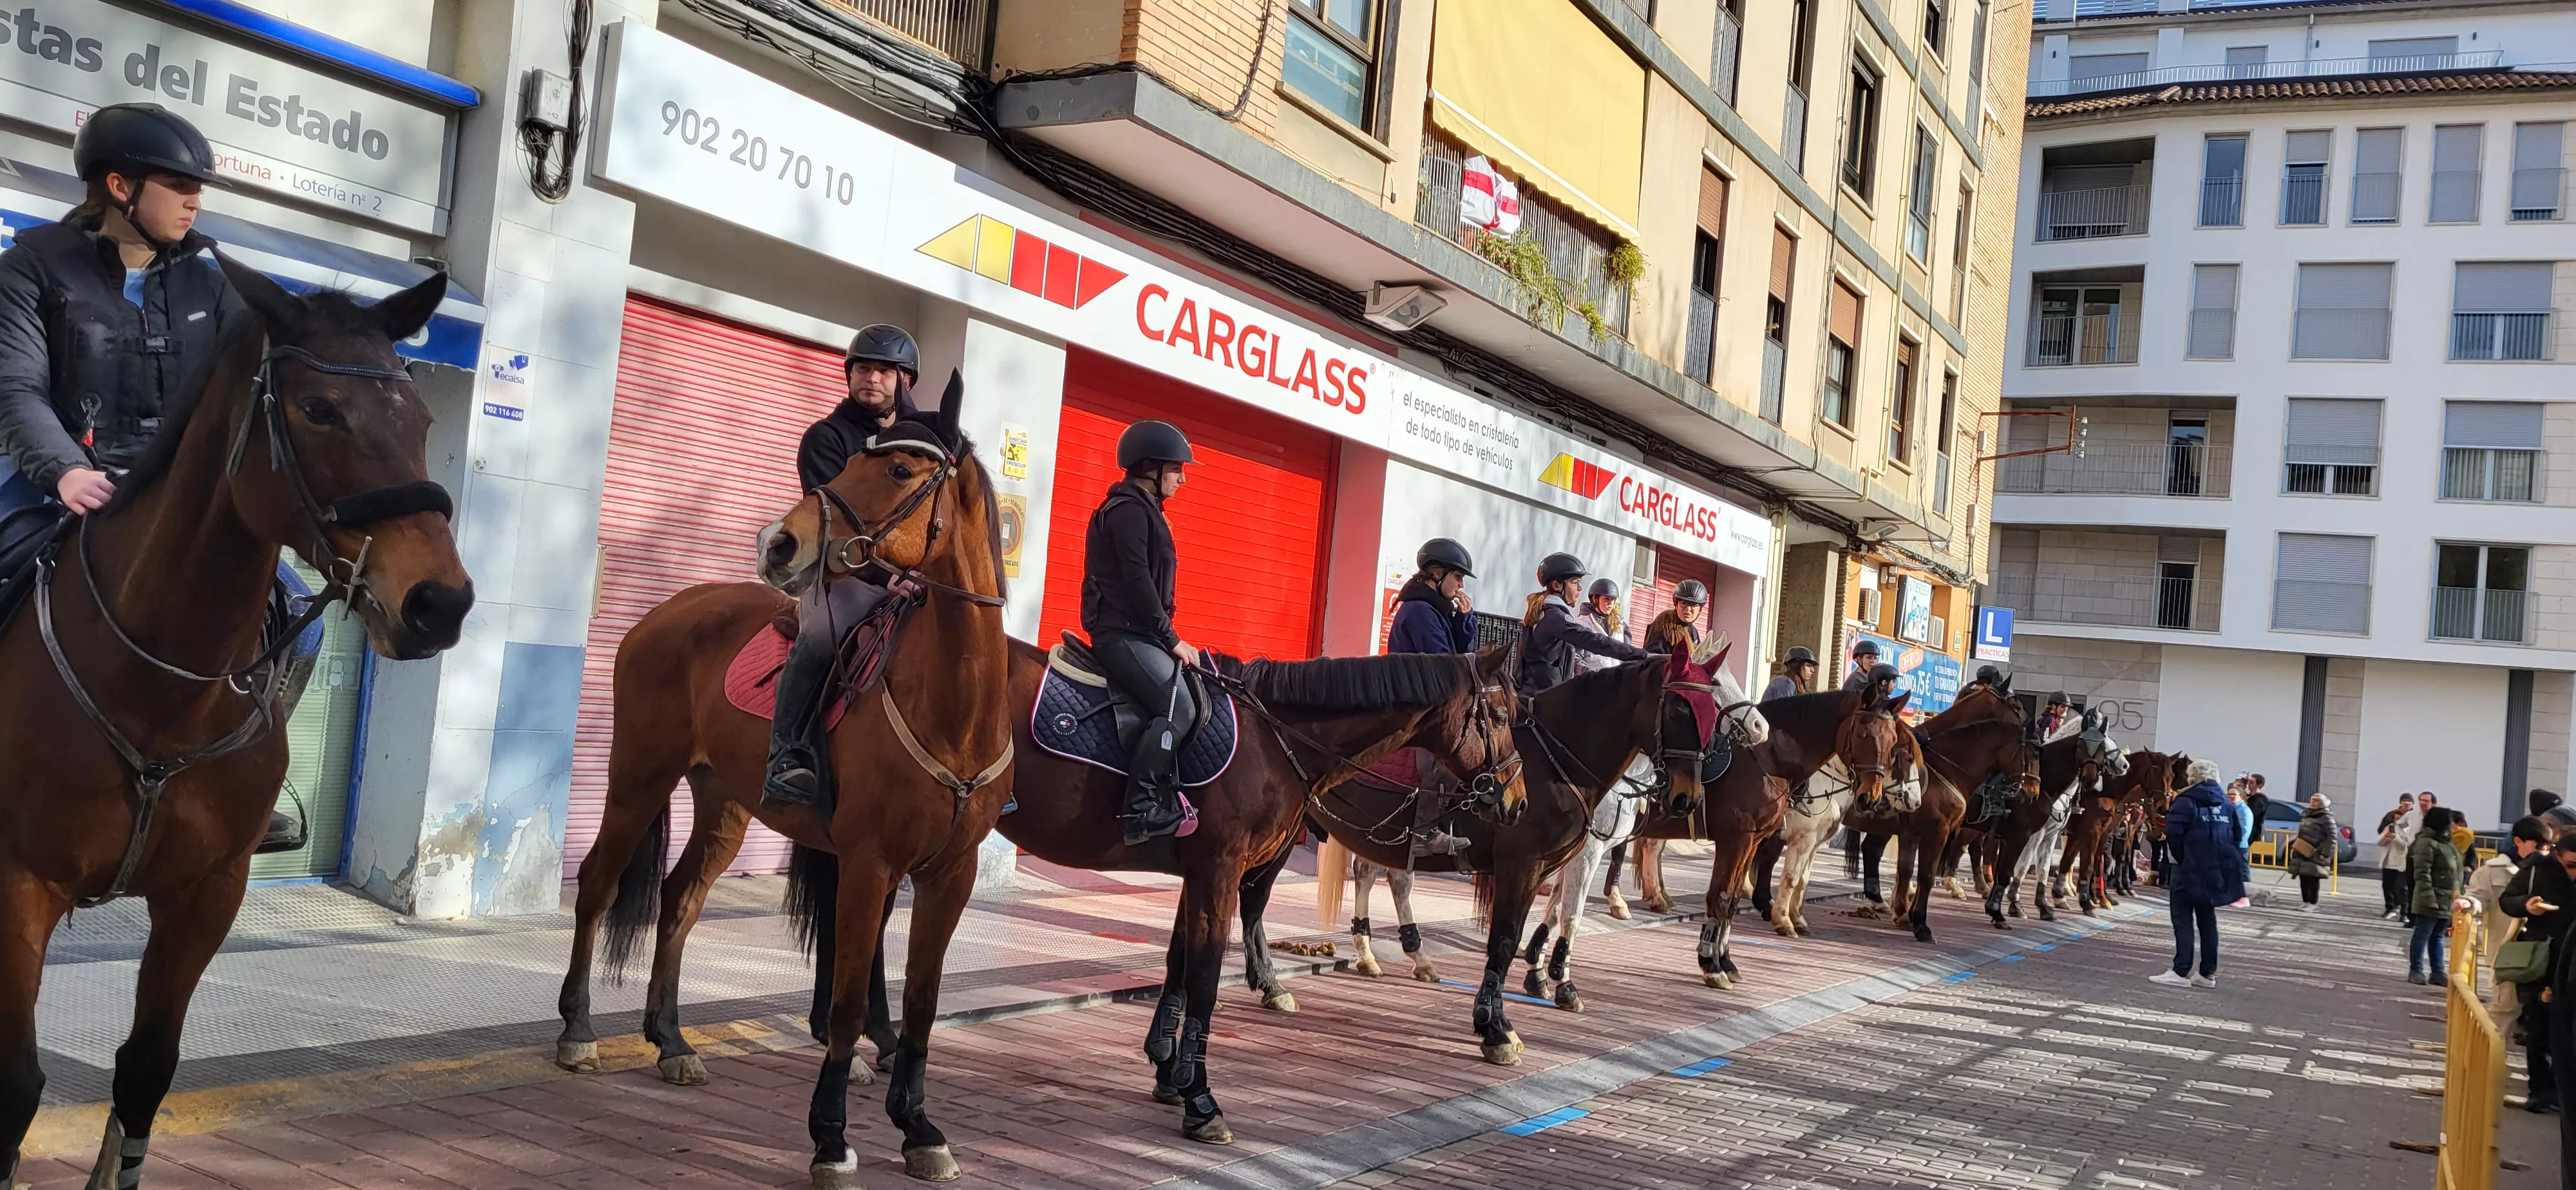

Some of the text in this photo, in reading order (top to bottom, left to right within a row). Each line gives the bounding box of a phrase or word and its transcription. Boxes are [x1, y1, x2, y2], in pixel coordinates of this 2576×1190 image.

[124, 42, 208, 107] del
[225, 73, 390, 161] Estado
[214, 153, 271, 180] ortuna
[661, 100, 854, 205] 902 20 70 10
[293, 173, 346, 203] Lotería
[373, 196, 382, 212] 2
[1136, 283, 1368, 415] CARGLASS
[485, 405, 497, 414] 902
[498, 407, 510, 416] 116
[1403, 391, 1519, 449] el especialista en cristalería
[1006, 460, 1027, 468] PROSEGUR
[1406, 418, 1513, 471] de todo tipo de vehículos
[1620, 476, 1717, 542] CARGLASS
[1985, 612, 2003, 643] L
[1879, 641, 1894, 666] CIÓN
[1978, 648, 2010, 657] PRACTICAS
